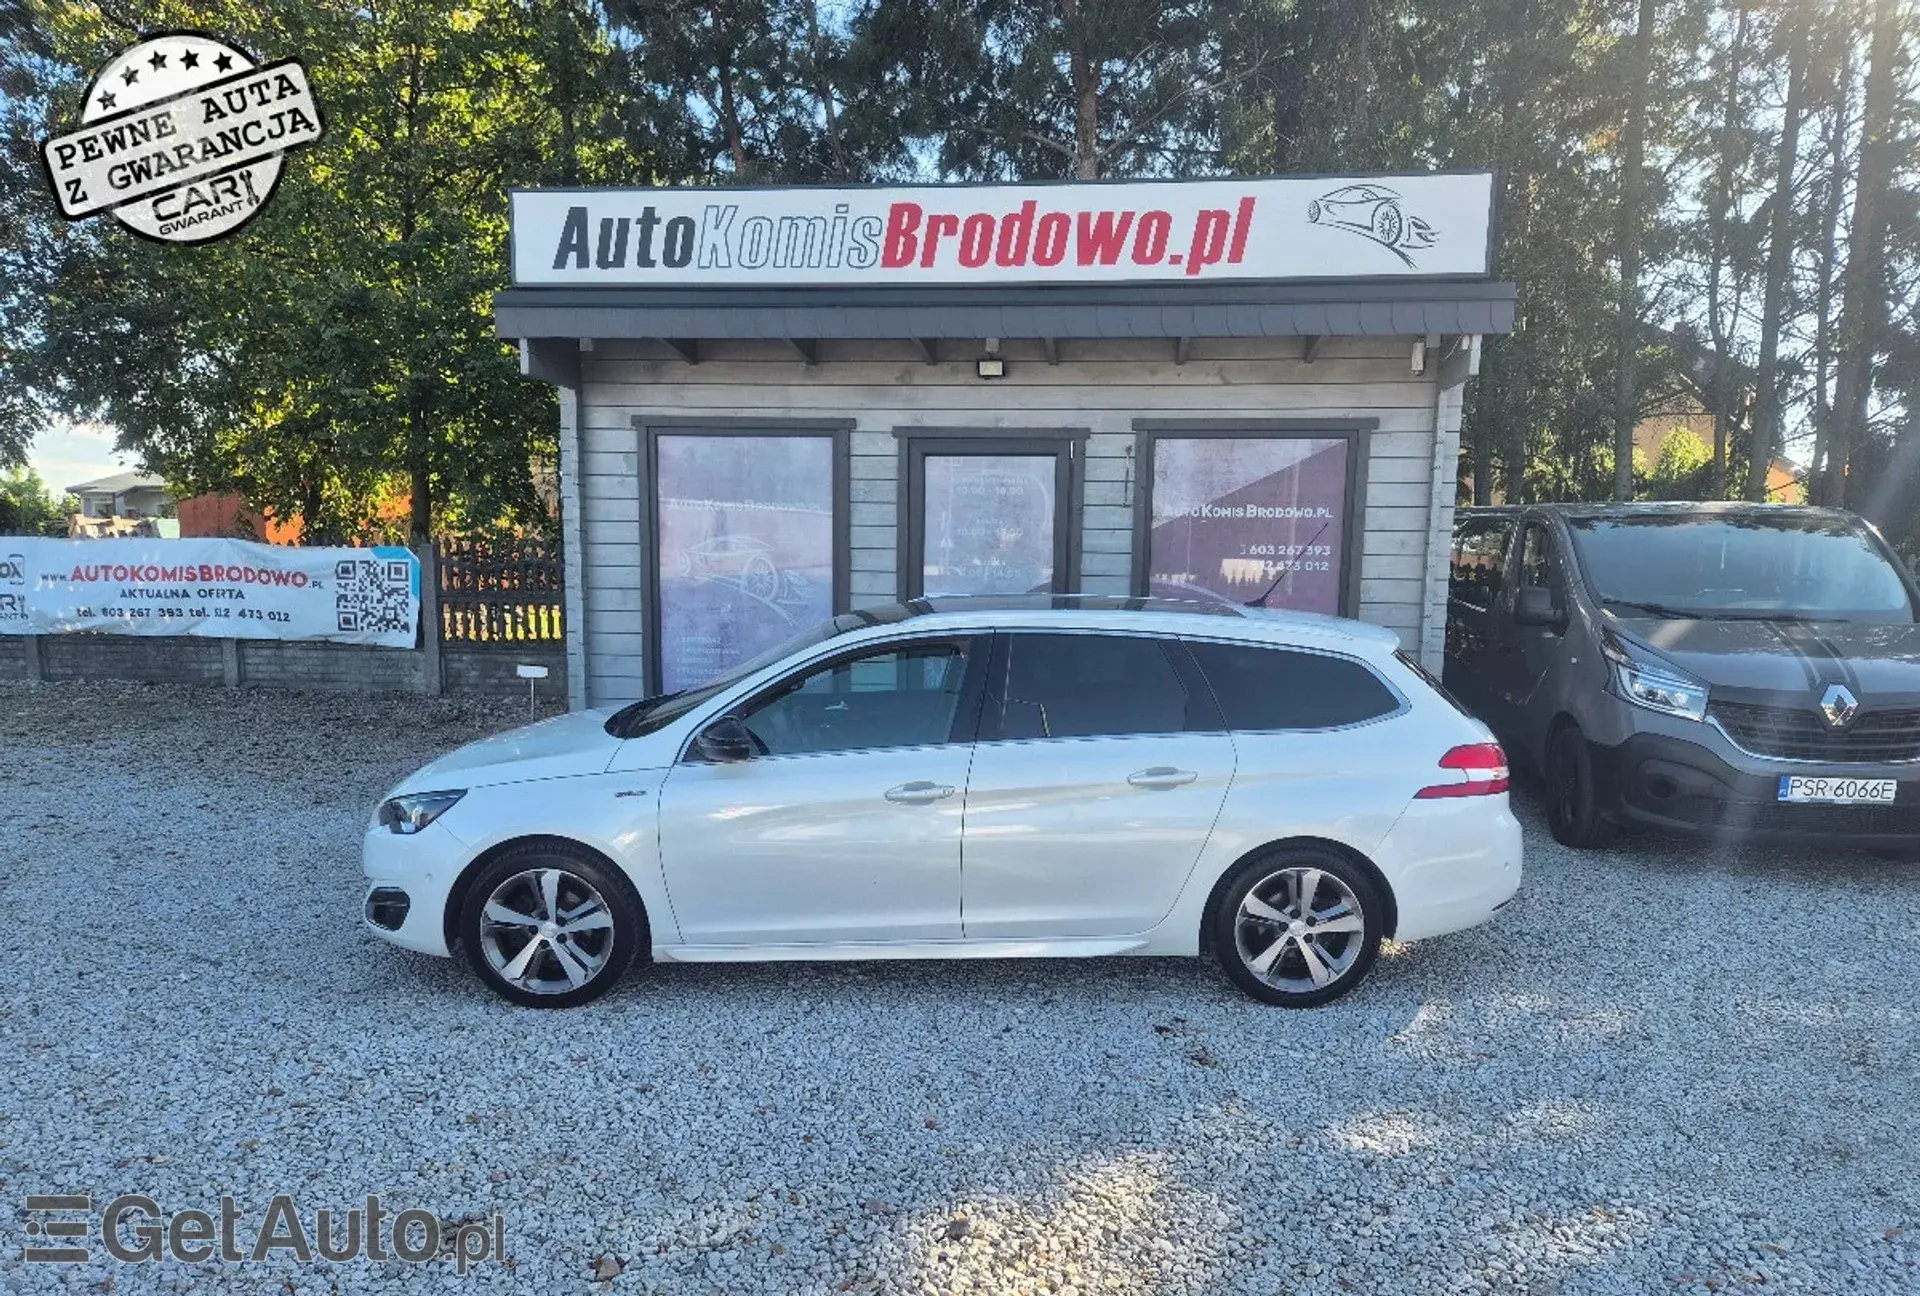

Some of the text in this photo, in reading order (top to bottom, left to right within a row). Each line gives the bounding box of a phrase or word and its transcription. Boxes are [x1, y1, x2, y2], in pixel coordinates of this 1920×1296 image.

[552, 196, 1256, 275] AutoKomisBrodowo.pl
[1249, 545, 1331, 556] 603 267 393
[1305, 561, 1329, 571] 012
[119, 588, 245, 600] AKTUALNA OFERTA
[76, 608, 96, 617] tel.
[102, 608, 124, 617] 603
[130, 608, 151, 617] 267
[158, 608, 183, 617] 393
[189, 607, 210, 617] tel.
[238, 608, 263, 620] 473
[268, 611, 290, 622] 012
[1790, 779, 1894, 799] PSR 6066E
